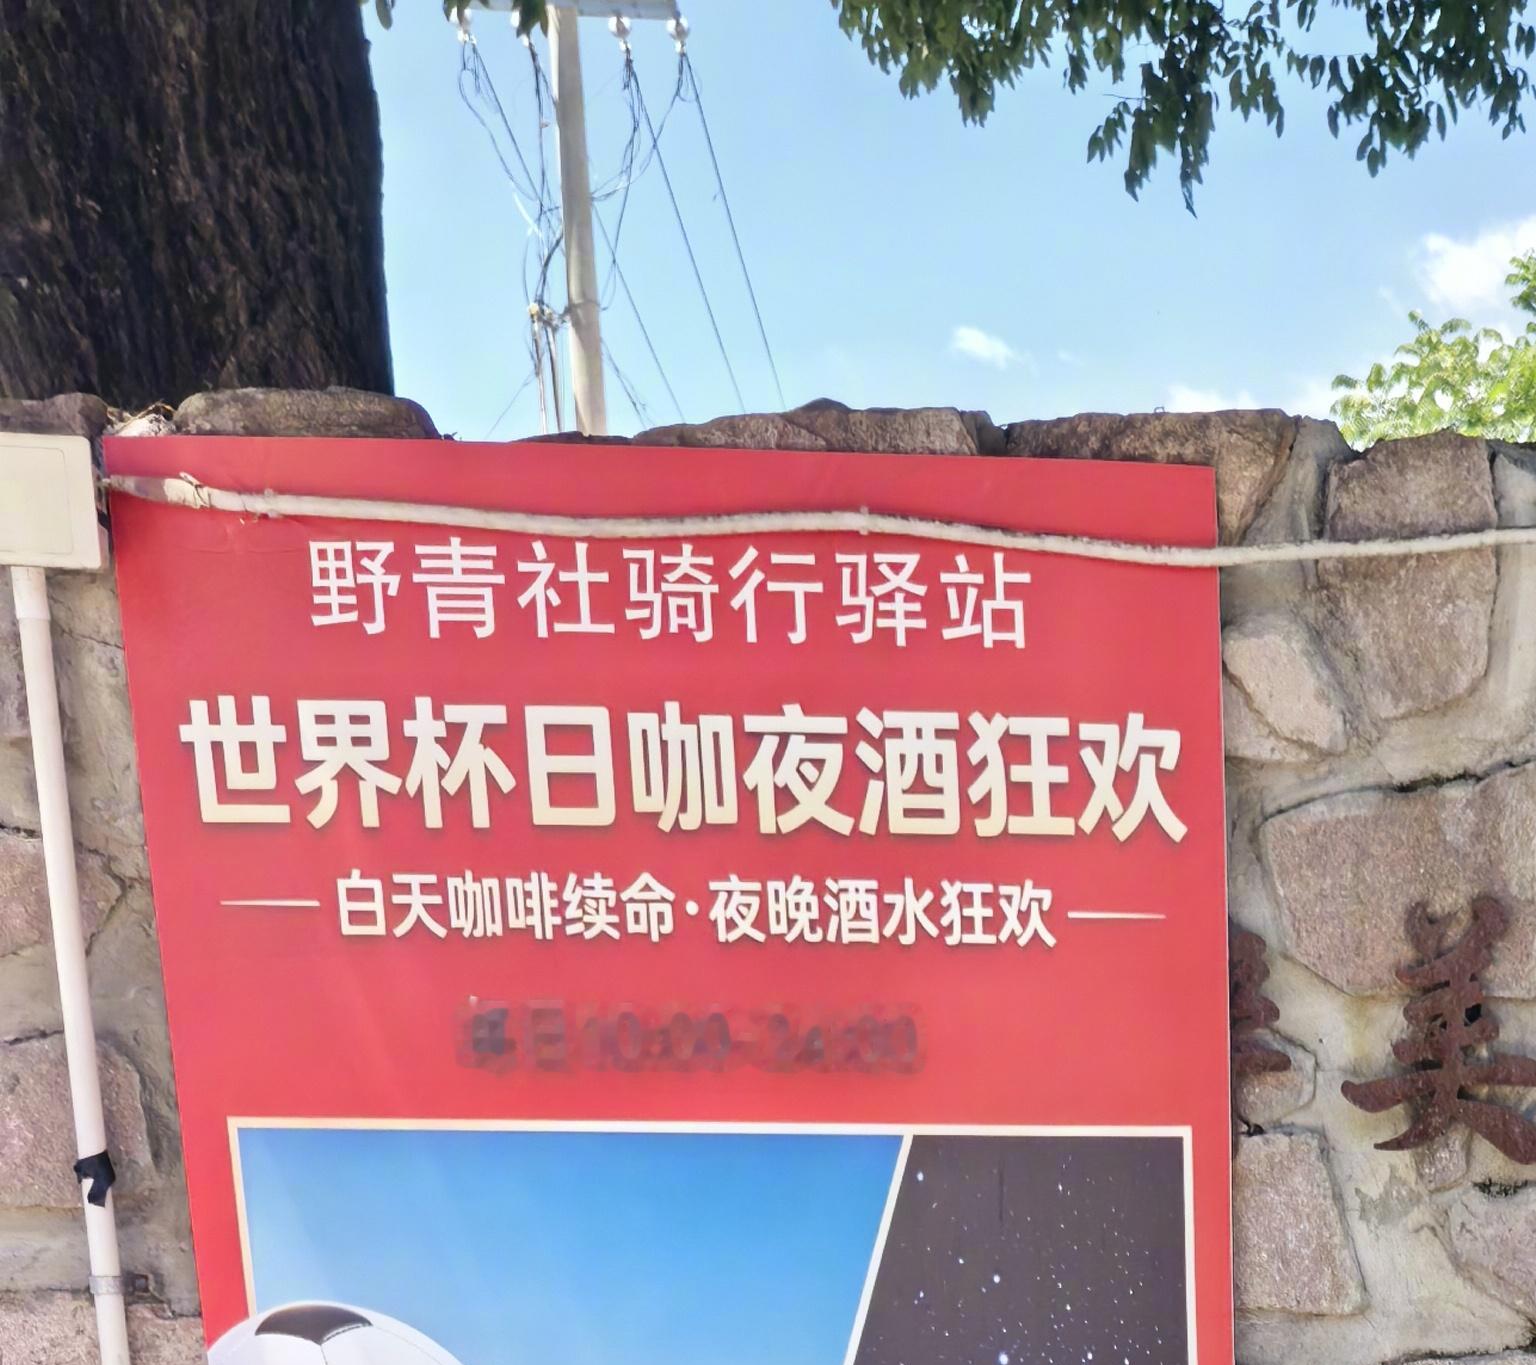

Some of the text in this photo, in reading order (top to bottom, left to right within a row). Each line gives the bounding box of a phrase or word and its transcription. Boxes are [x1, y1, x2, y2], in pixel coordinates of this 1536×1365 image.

[309, 537, 1032, 650] 野青社骑行驿站
[179, 693, 1188, 844] 世界杯日咖夜酒狂欢
